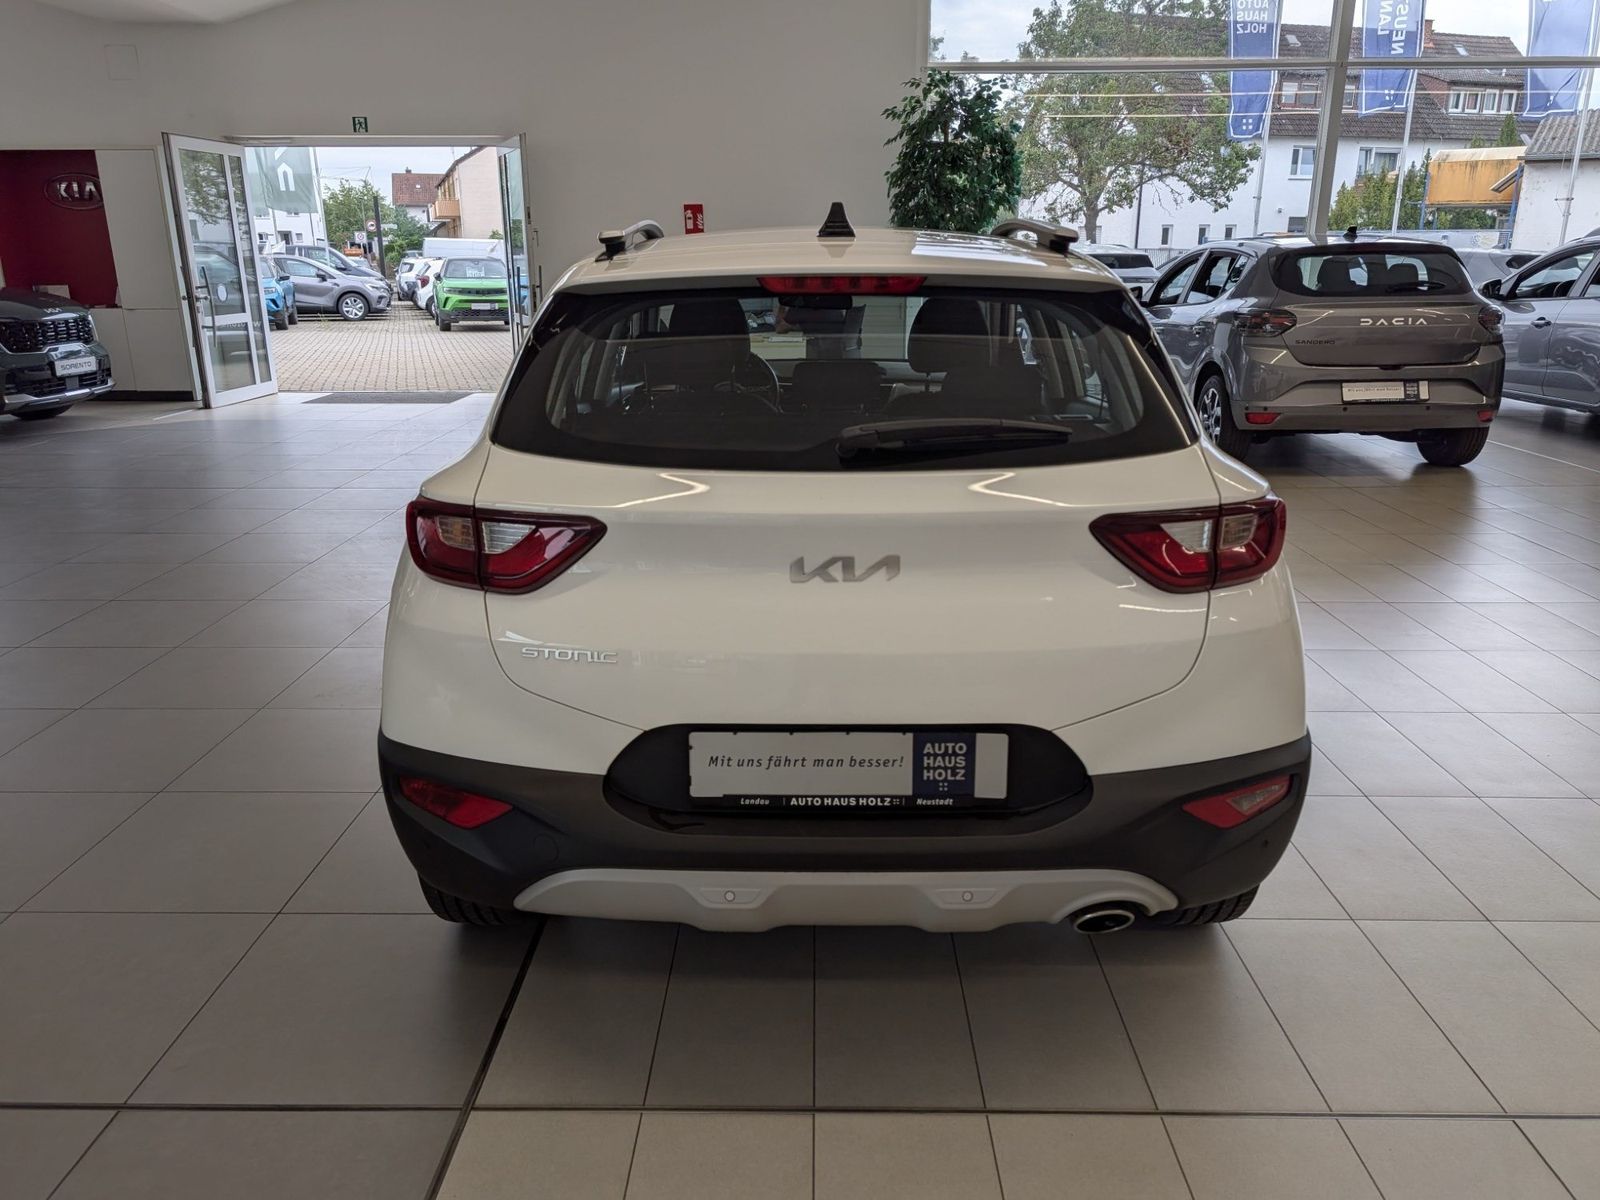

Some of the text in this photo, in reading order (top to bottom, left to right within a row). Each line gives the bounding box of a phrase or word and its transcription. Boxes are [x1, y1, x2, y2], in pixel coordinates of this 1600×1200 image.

[57, 181, 101, 202] KIA
[1359, 317, 1427, 326] DACIA
[60, 361, 92, 371] SORENTO
[789, 554, 901, 584] KIA
[520, 646, 619, 664] STONIC
[923, 743, 967, 754] AUTO
[708, 754, 905, 772] Mit uns fährt man besser!
[923, 756, 966, 767] HAUS
[923, 769, 966, 781] HOLZ
[740, 797, 954, 807] Landau AUTO HAUS HOLZ Neustadt
